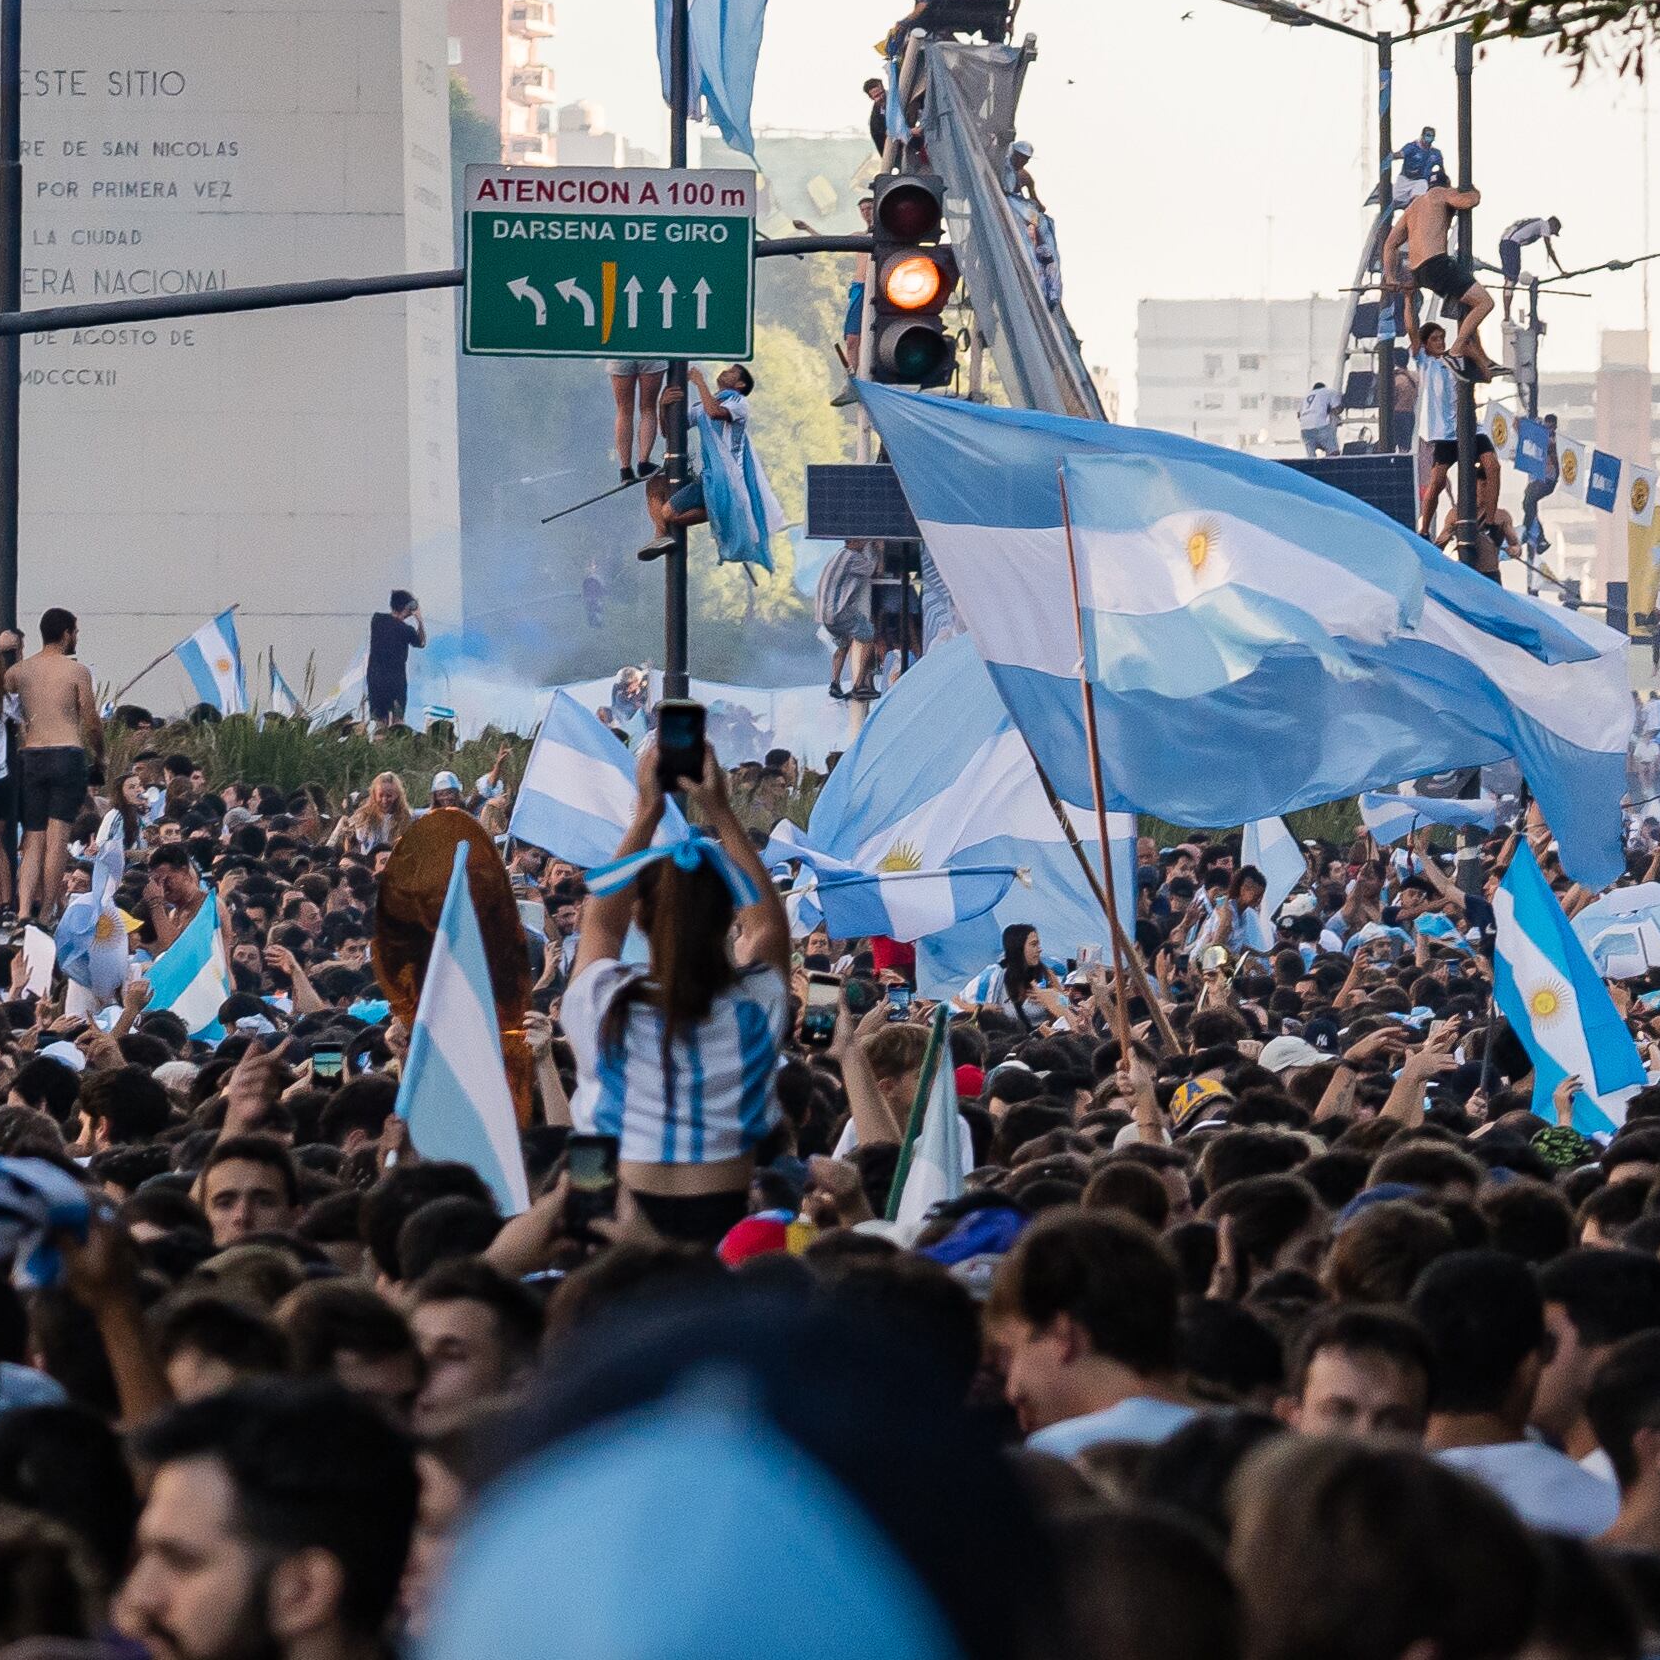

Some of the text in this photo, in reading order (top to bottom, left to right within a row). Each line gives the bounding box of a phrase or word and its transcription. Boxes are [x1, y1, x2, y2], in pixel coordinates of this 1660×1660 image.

[109, 70, 186, 96] SITIO
[63, 141, 88, 157] DE
[102, 141, 139, 158] SAN
[153, 141, 239, 158] NICOLAS
[36, 181, 79, 199] POR
[92, 181, 178, 199] PRIMERA
[194, 181, 234, 199] VEZ
[476, 178, 746, 207] ATENCION A 100 m
[33, 229, 142, 246] LA CIUDAD
[492, 218, 729, 244] DARSENA DE GIRO
[34, 330, 195, 347] DE AGOSTO DE
